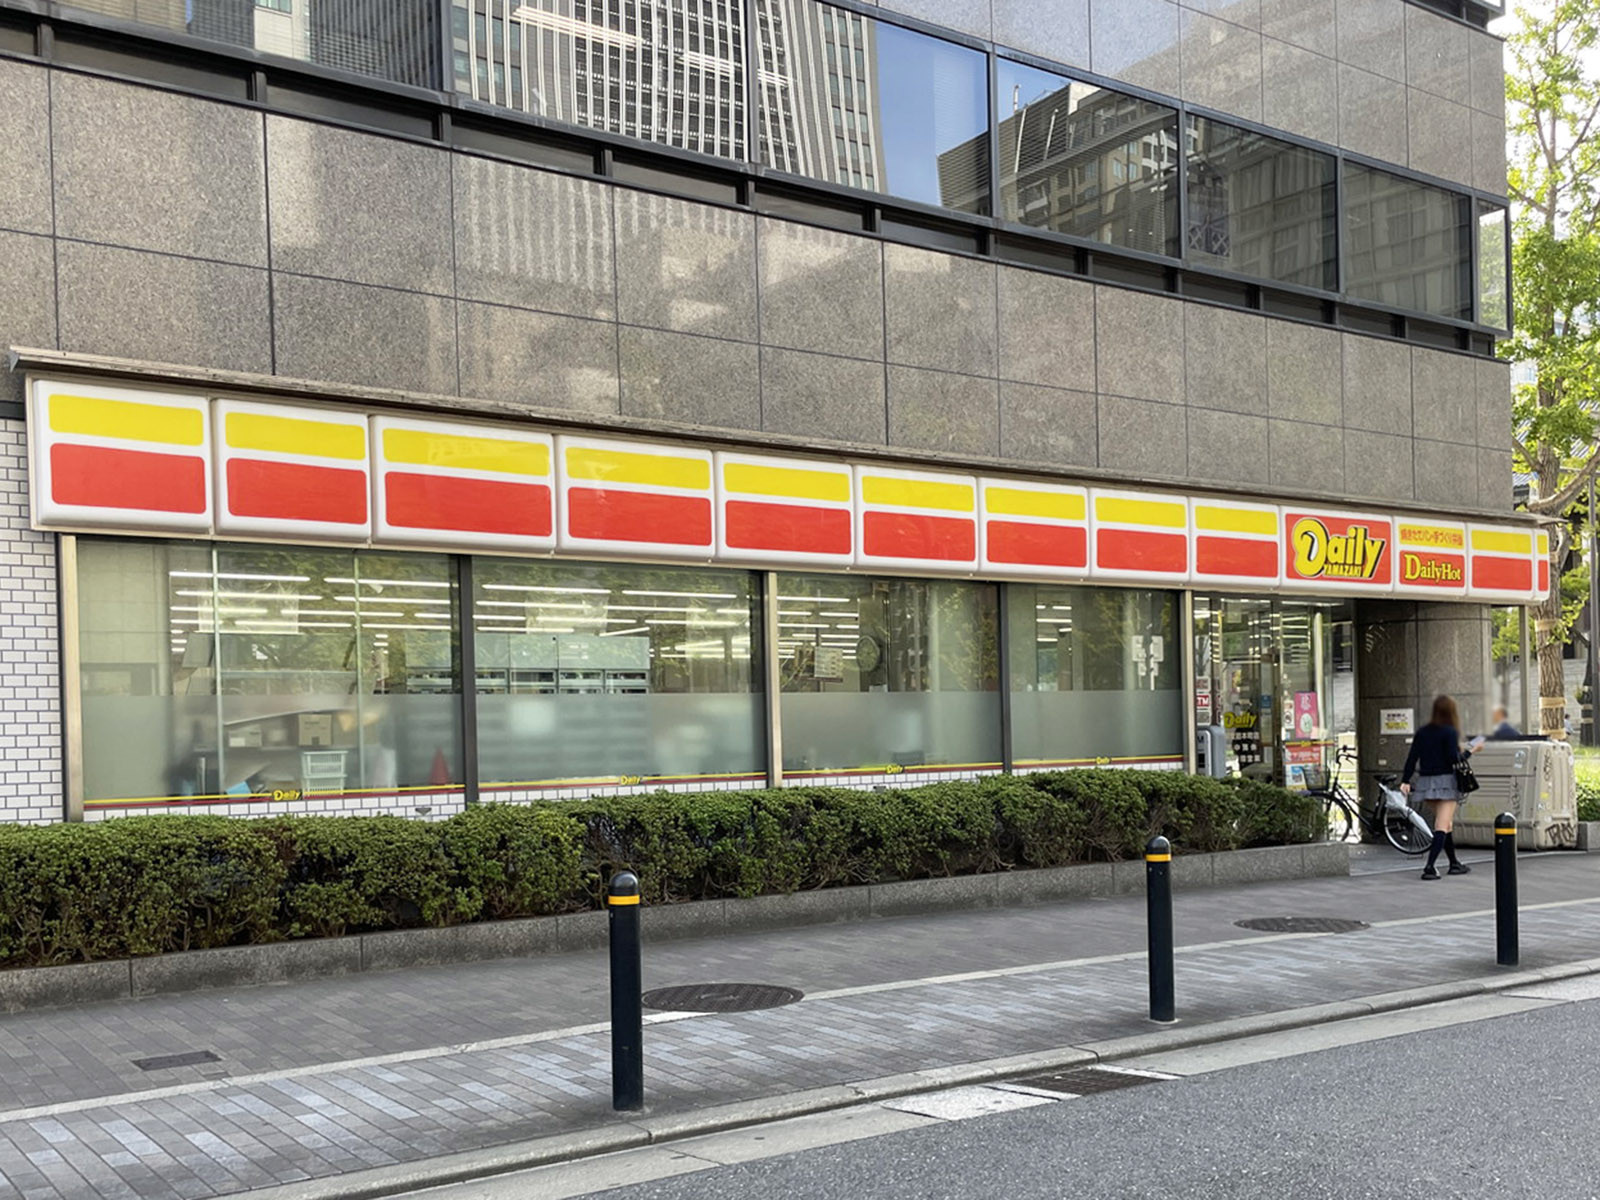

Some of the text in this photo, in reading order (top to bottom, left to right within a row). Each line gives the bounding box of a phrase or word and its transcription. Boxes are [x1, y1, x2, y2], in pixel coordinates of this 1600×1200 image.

[1293, 518, 1385, 578] Daily
[1324, 564, 1363, 577] YAMAZAKI
[1403, 553, 1462, 583] DailyHot
[1224, 711, 1257, 728] Daily
